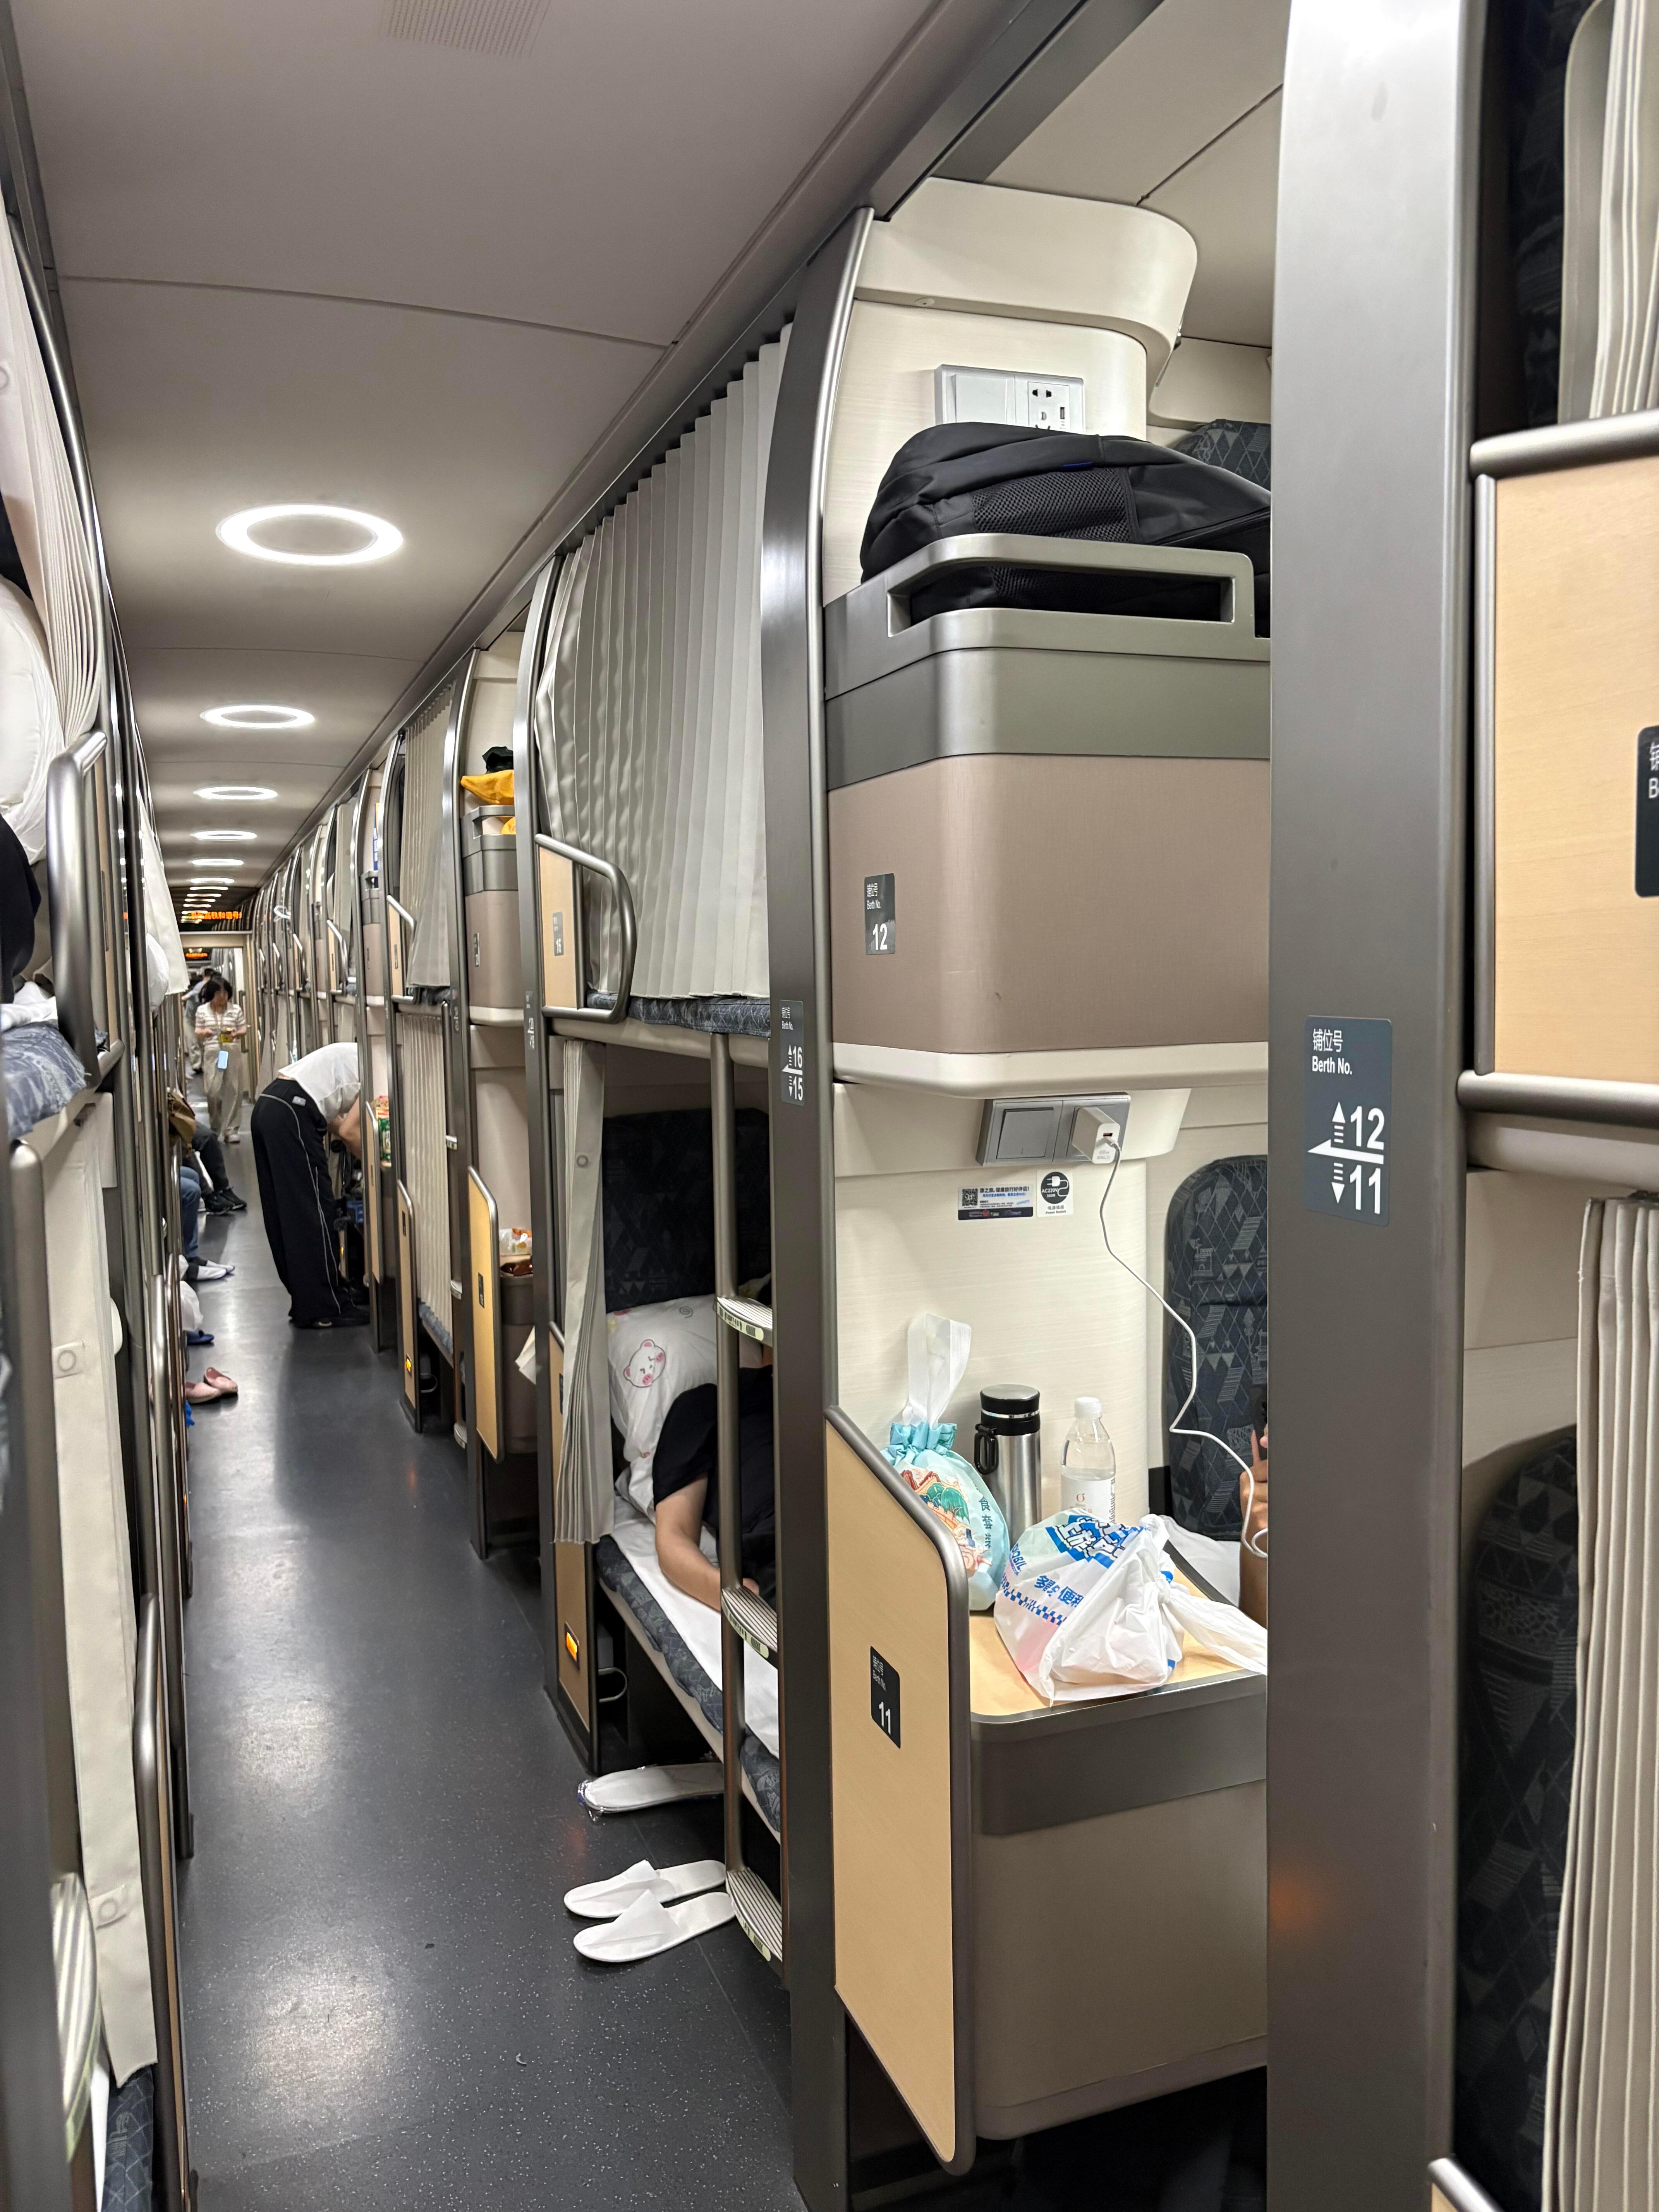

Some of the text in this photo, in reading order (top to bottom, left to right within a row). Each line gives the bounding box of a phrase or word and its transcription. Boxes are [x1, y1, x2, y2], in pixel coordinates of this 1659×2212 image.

[873, 923, 888, 950] 12
[1312, 1028, 1343, 1053] 铺位号
[793, 1046, 802, 1068] 16
[1312, 1056, 1352, 1075] Berth No.
[793, 1076, 803, 1101] 15
[1350, 1106, 1385, 1150] 12
[1350, 1165, 1381, 1214] 11
[879, 1701, 891, 1735] 11
